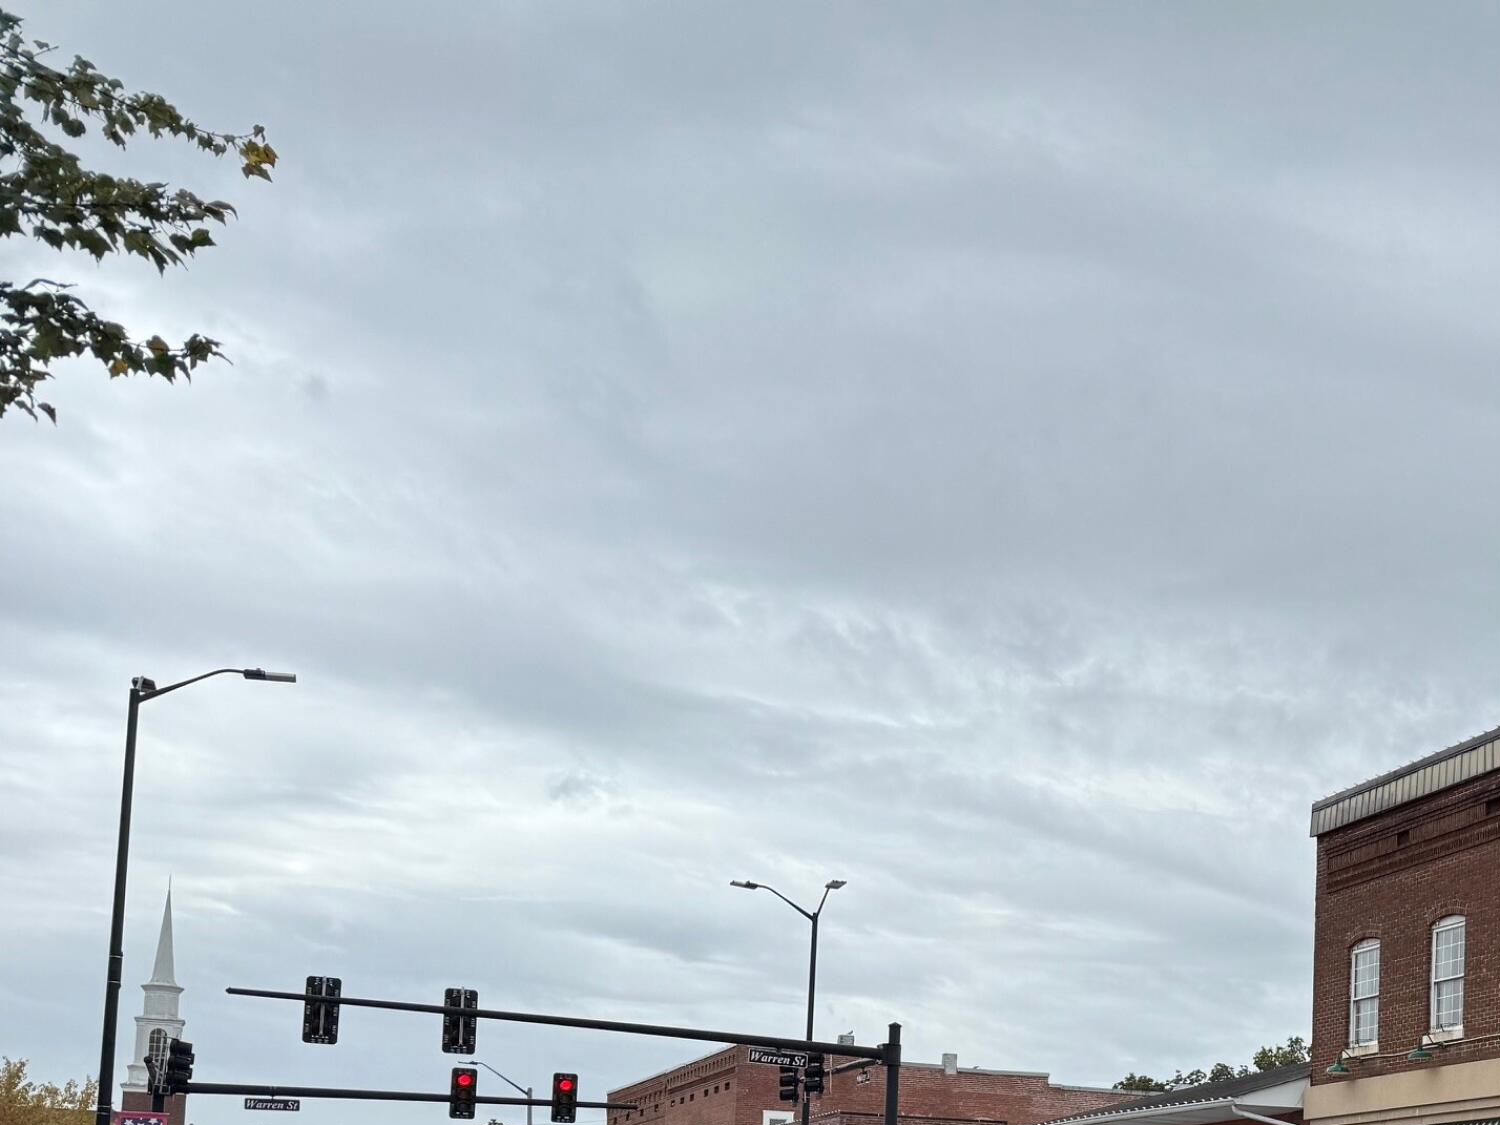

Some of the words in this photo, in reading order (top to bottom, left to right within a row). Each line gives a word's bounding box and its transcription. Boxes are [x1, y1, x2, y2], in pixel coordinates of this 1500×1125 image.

[750, 1050, 790, 1065] Warren
[792, 1056, 805, 1066] St
[246, 1099, 284, 1110] Warren
[286, 1100, 299, 1110] St
